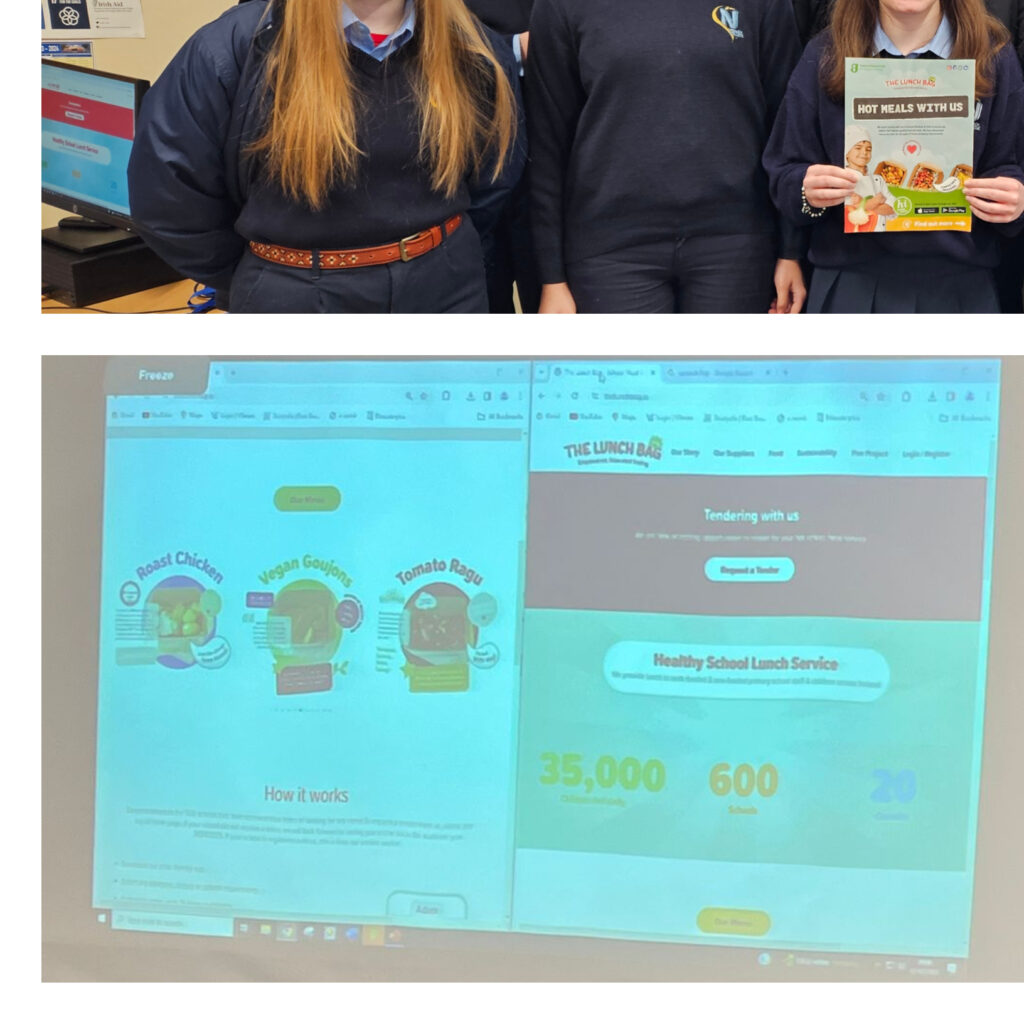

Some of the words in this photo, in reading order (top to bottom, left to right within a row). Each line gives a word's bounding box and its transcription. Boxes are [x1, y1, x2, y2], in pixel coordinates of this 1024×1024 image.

[923, 79, 936, 88] BAG
[857, 104, 878, 114] HOT
[880, 103, 914, 114] MEALS
[916, 102, 947, 113] WITH
[949, 102, 964, 112] US
[138, 369, 174, 381] Freeze
[564, 442, 591, 458] THE
[593, 441, 634, 455] LUNCH
[636, 442, 662, 461] BAG
[704, 509, 758, 524] Tendering
[761, 509, 784, 521] with
[787, 510, 799, 521] us
[136, 553, 173, 581] Roast
[175, 551, 224, 585] Chicken
[257, 558, 299, 585] Vegan
[302, 554, 353, 588] Goujons
[395, 558, 446, 585] Tomato
[449, 557, 484, 586] Ragu
[654, 652, 703, 671] Healthy
[706, 655, 749, 670] School
[751, 656, 789, 670] Lunch
[791, 656, 839, 671] Service
[538, 751, 667, 794] 35,000
[709, 762, 779, 797] 600
[264, 785, 294, 803] How
[297, 786, 306, 803] it
[308, 787, 349, 804] works
[870, 768, 918, 805] 20
